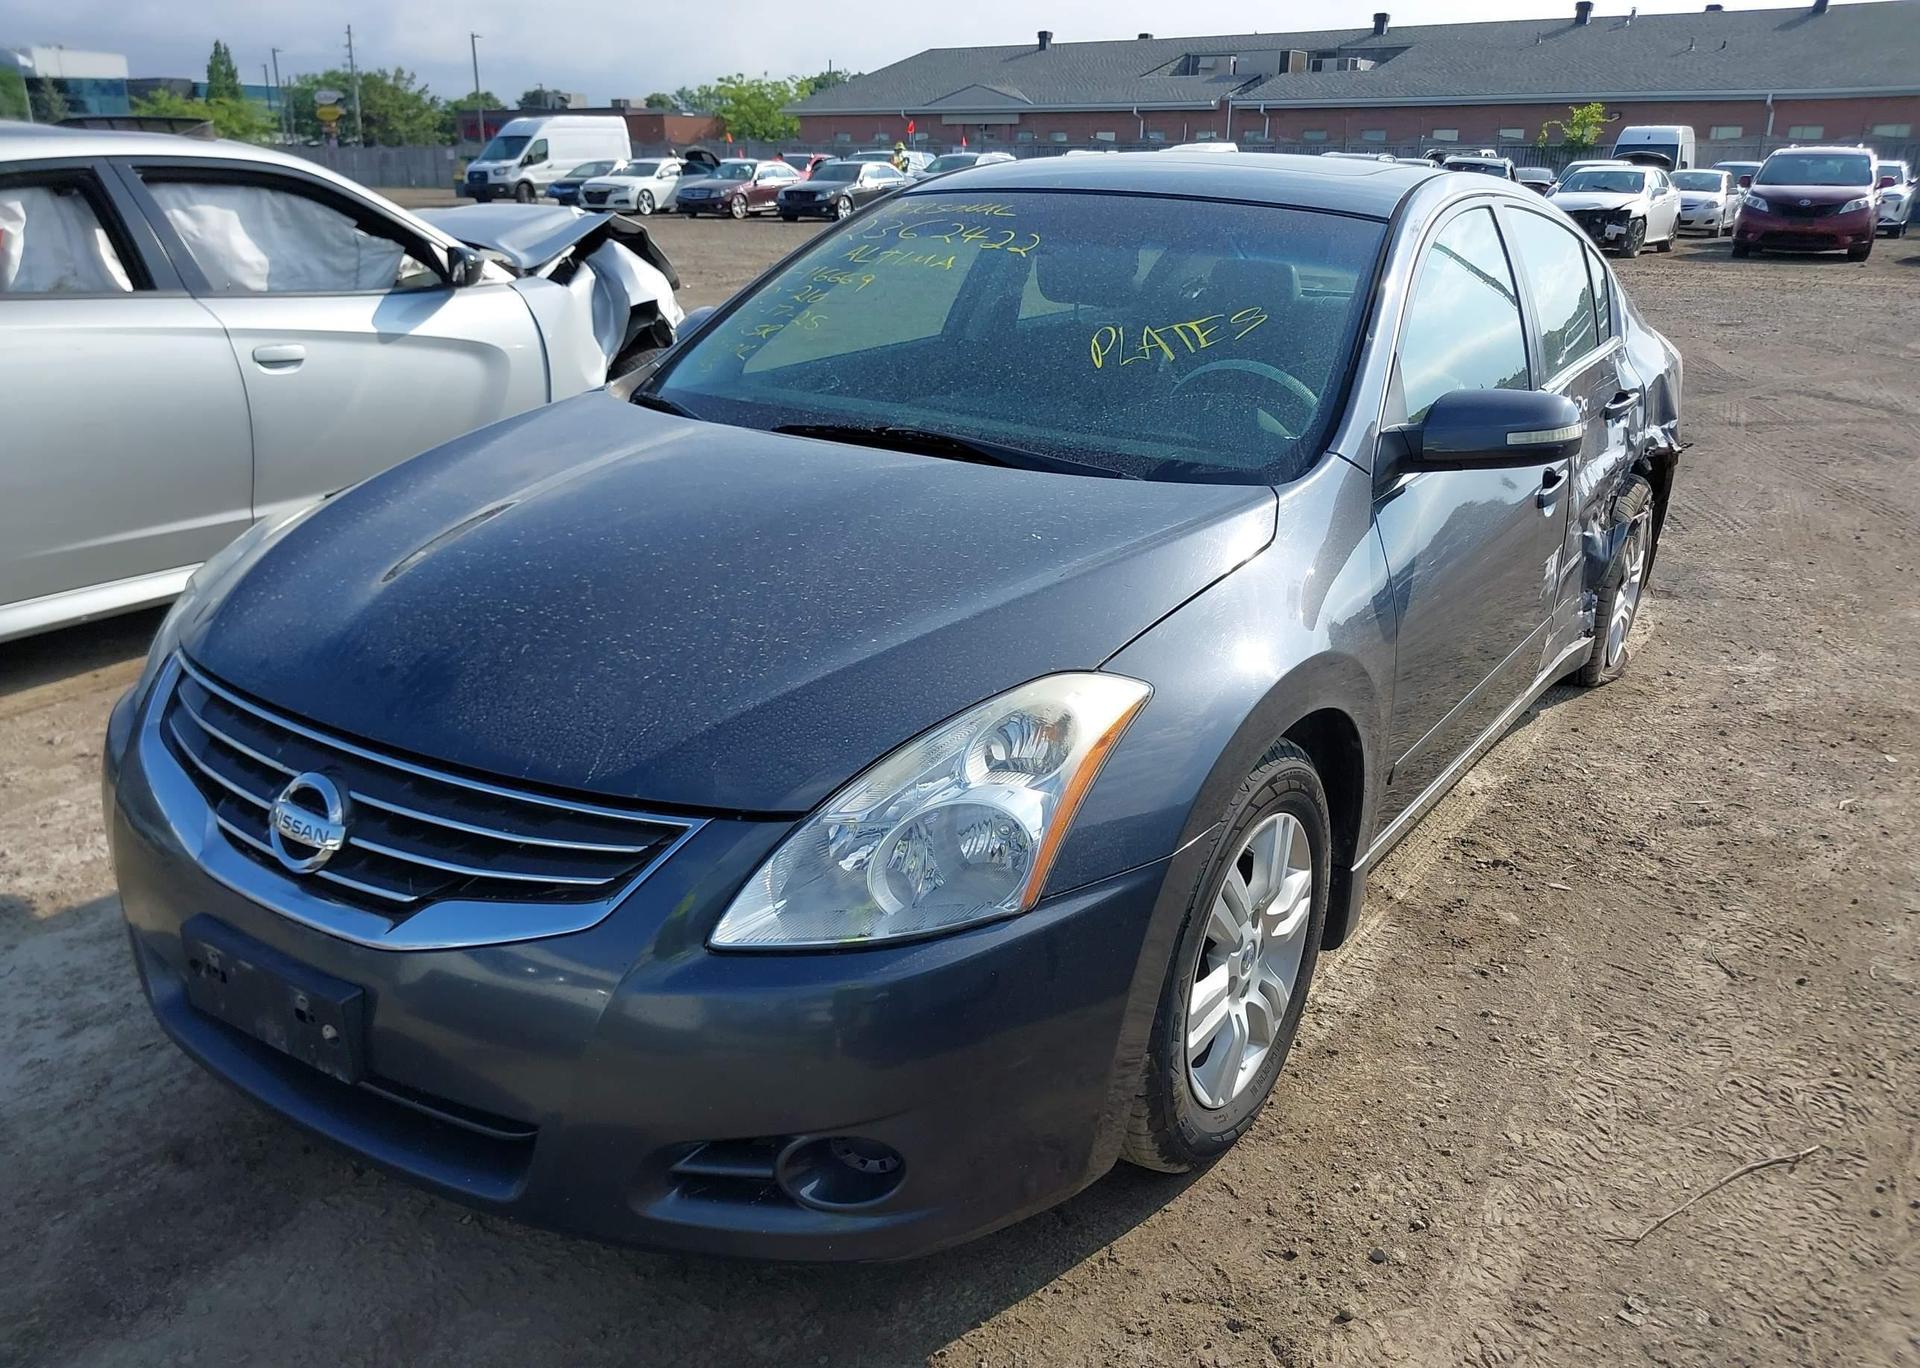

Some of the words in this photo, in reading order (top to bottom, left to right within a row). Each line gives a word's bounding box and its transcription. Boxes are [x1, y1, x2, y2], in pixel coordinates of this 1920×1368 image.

[837, 244, 956, 271] ALTIMA
[1090, 306, 1268, 369] PLATES
[273, 808, 330, 843] NISSAN
